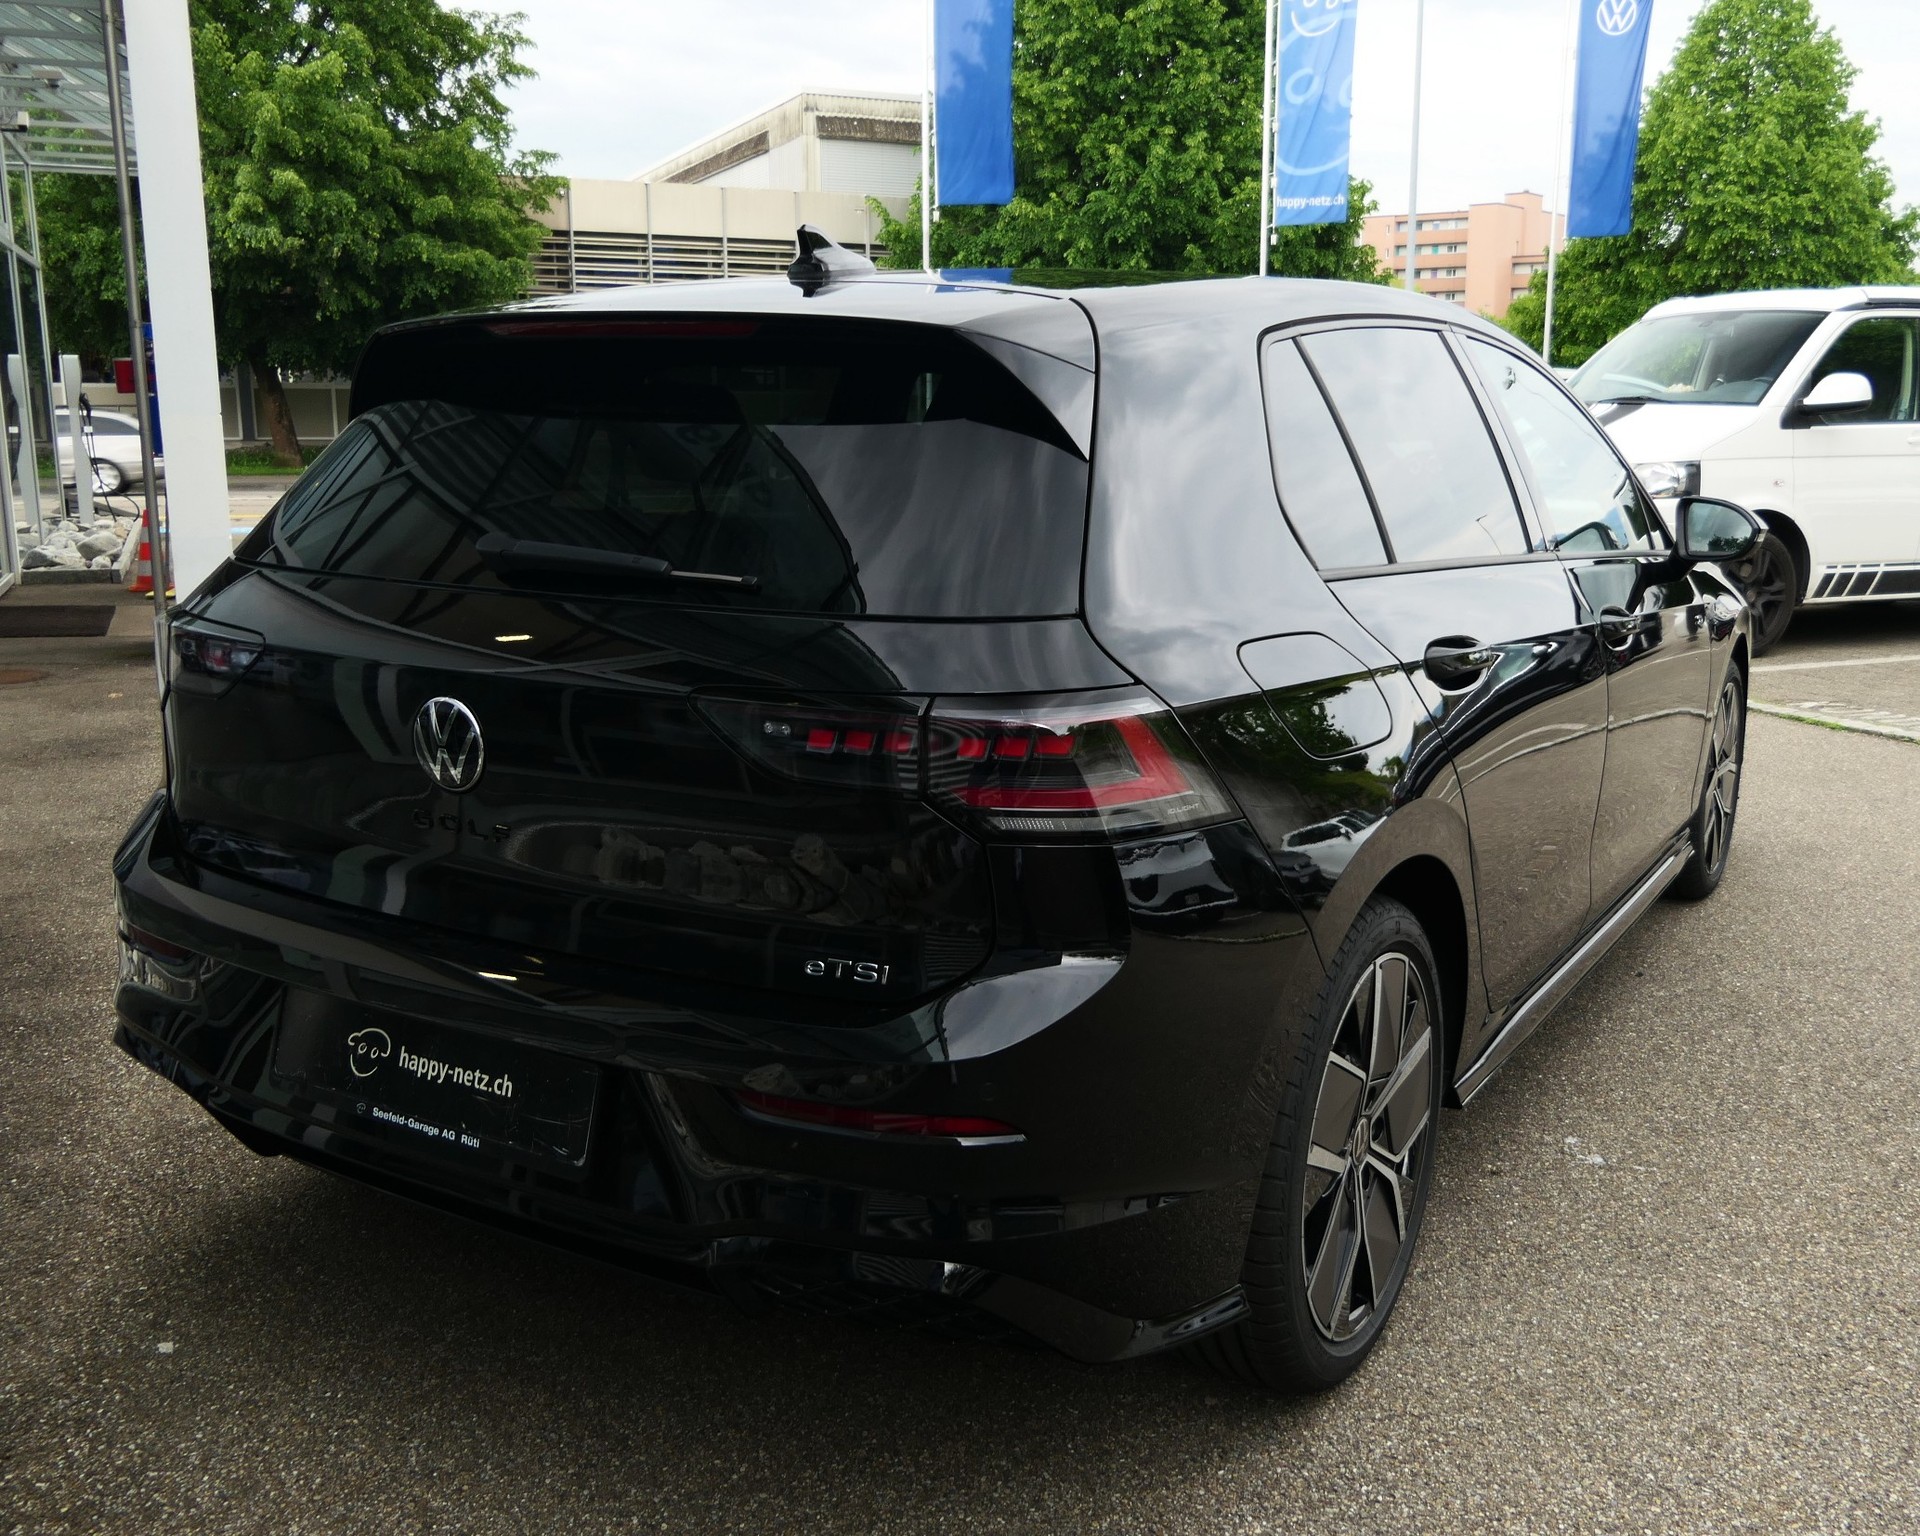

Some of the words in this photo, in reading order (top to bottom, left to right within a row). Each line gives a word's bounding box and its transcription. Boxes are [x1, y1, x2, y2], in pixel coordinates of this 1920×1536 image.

[1276, 194, 1345, 210] happy-netz.ch
[804, 957, 890, 985] eTSI
[398, 1045, 513, 1098] happy-netz.ch
[372, 1106, 439, 1136] Seefeld-Garage
[441, 1128, 456, 1141] AG
[460, 1133, 481, 1149] Rüti
